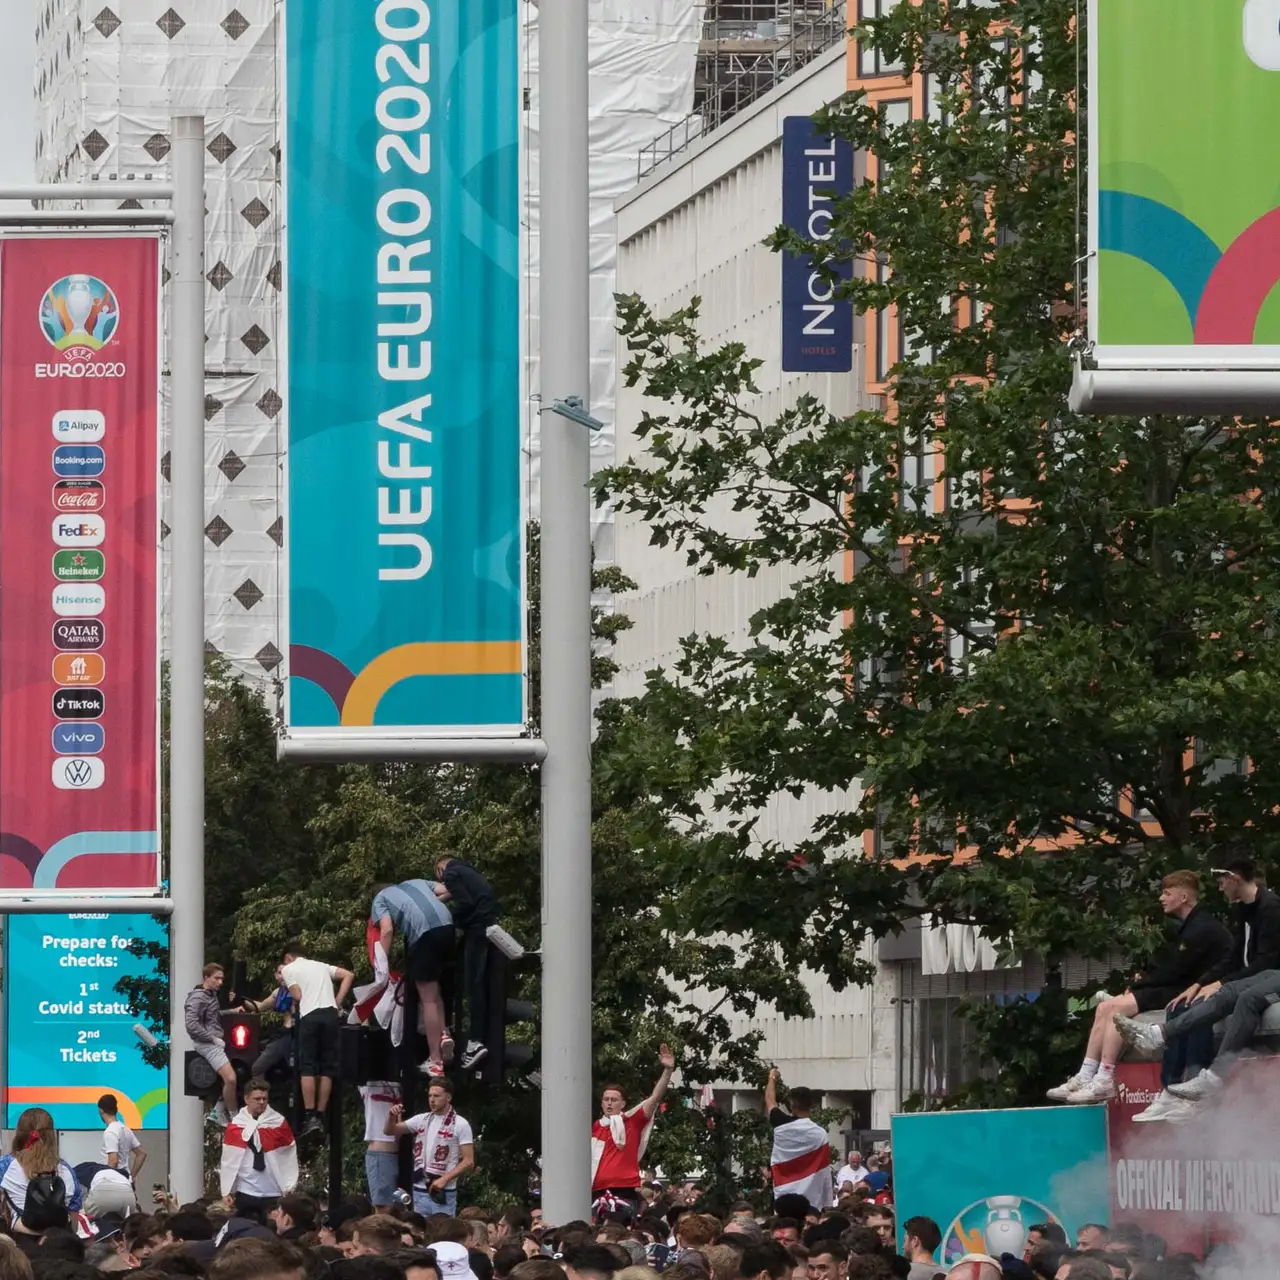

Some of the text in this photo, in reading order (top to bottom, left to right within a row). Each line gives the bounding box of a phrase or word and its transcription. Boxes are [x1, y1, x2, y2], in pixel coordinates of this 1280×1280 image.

[802, 133, 836, 335] NOOTEL
[375, 0, 433, 581] UEFA EURO 2020
[63, 347, 96, 361] UEFA
[71, 420, 99, 431] Alipay
[55, 456, 103, 466] Booking.com
[59, 524, 97, 537] FedEx
[58, 566, 100, 576] Heineken
[56, 595, 101, 605] Hisense
[58, 625, 99, 638] QATAR
[67, 635, 100, 643] AIRWAYS
[68, 700, 100, 710] TikTok
[62, 732, 96, 742] vivo
[42, 935, 106, 951] Prepare
[59, 953, 118, 967] checks:
[38, 1001, 83, 1015] Covid
[77, 1030, 100, 1044] 2nd
[60, 1048, 117, 1063] Tickets
[1117, 1159, 1183, 1211] OFFICIAL
